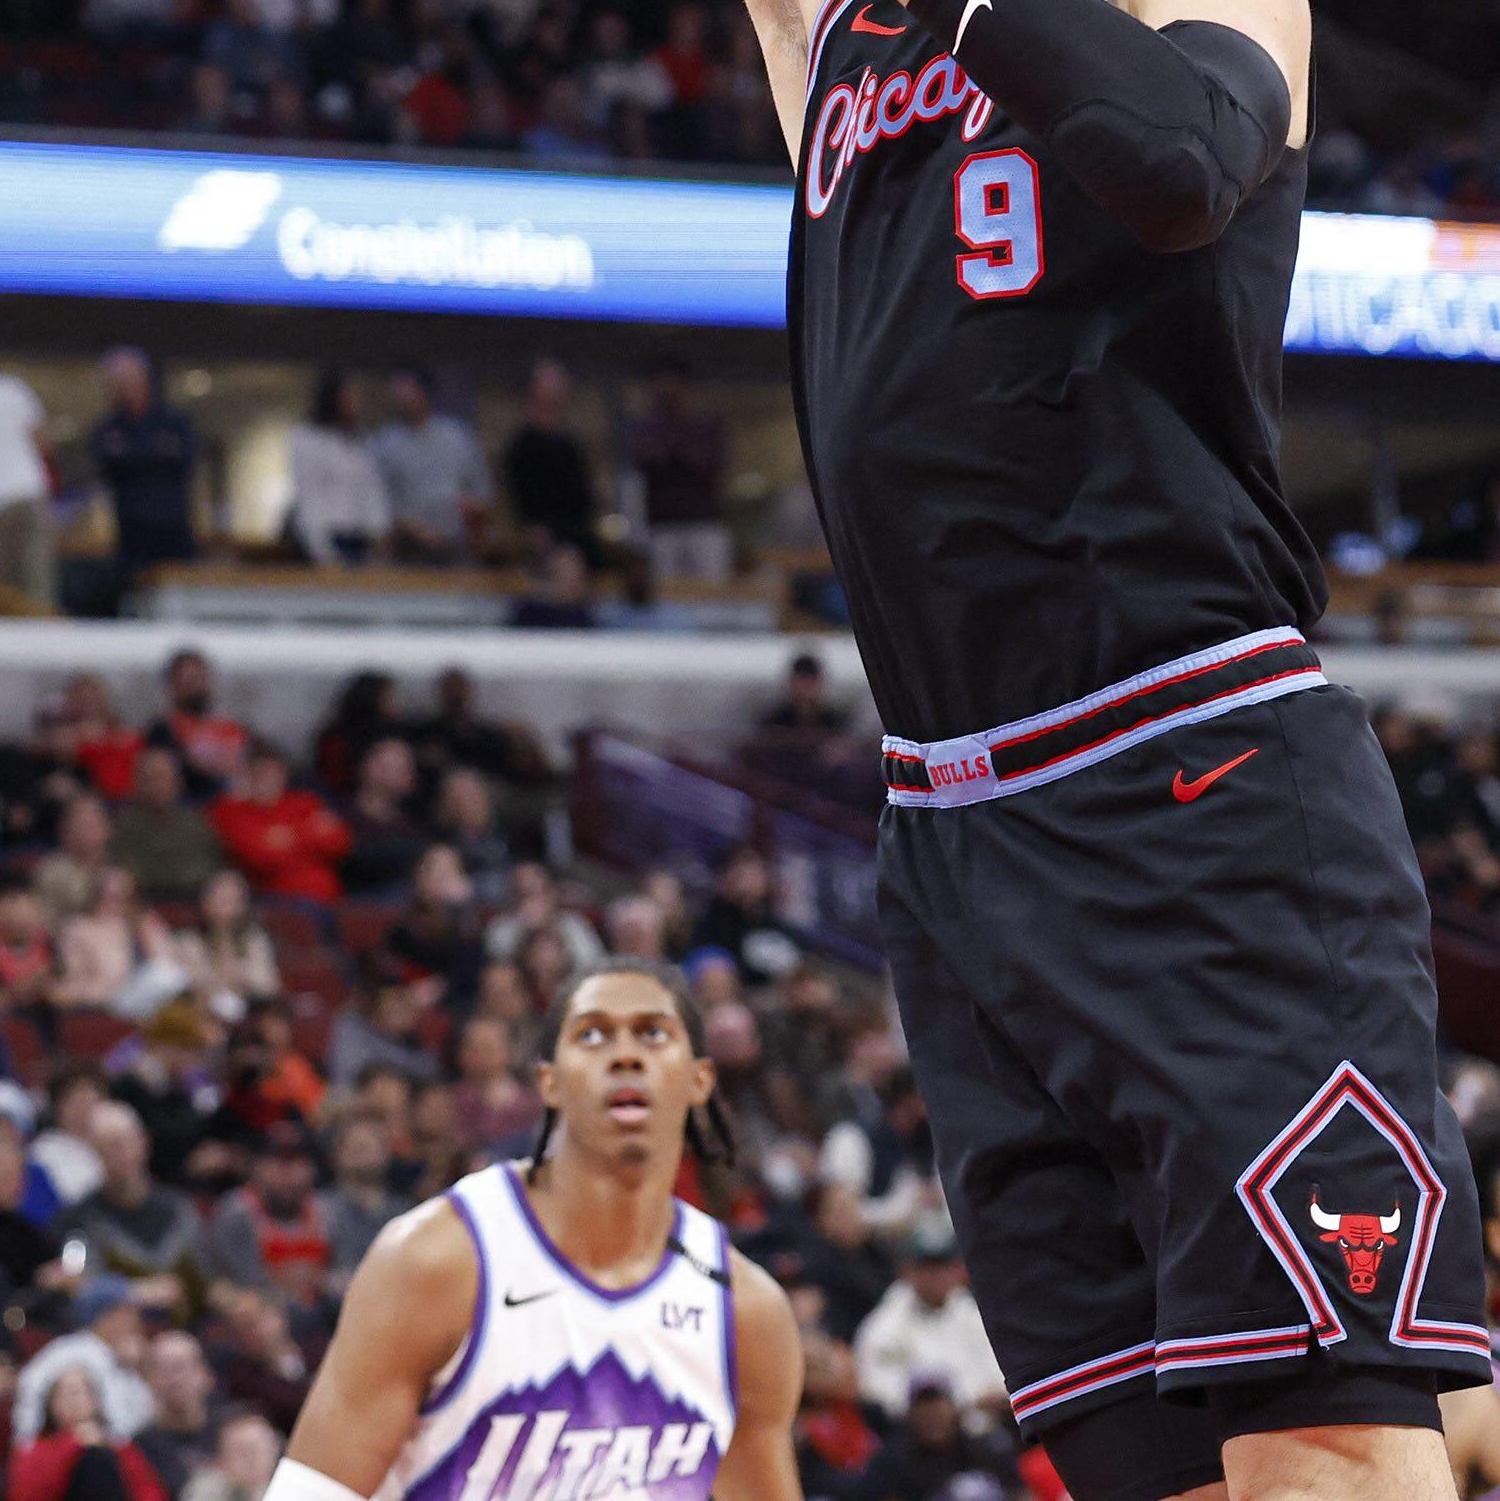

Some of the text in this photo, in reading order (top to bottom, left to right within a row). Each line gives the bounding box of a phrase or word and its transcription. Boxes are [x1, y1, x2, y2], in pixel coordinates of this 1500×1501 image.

[954, 147, 1045, 300] 9
[928, 755, 989, 787] BULLS
[457, 1409, 713, 1501] UTAH
